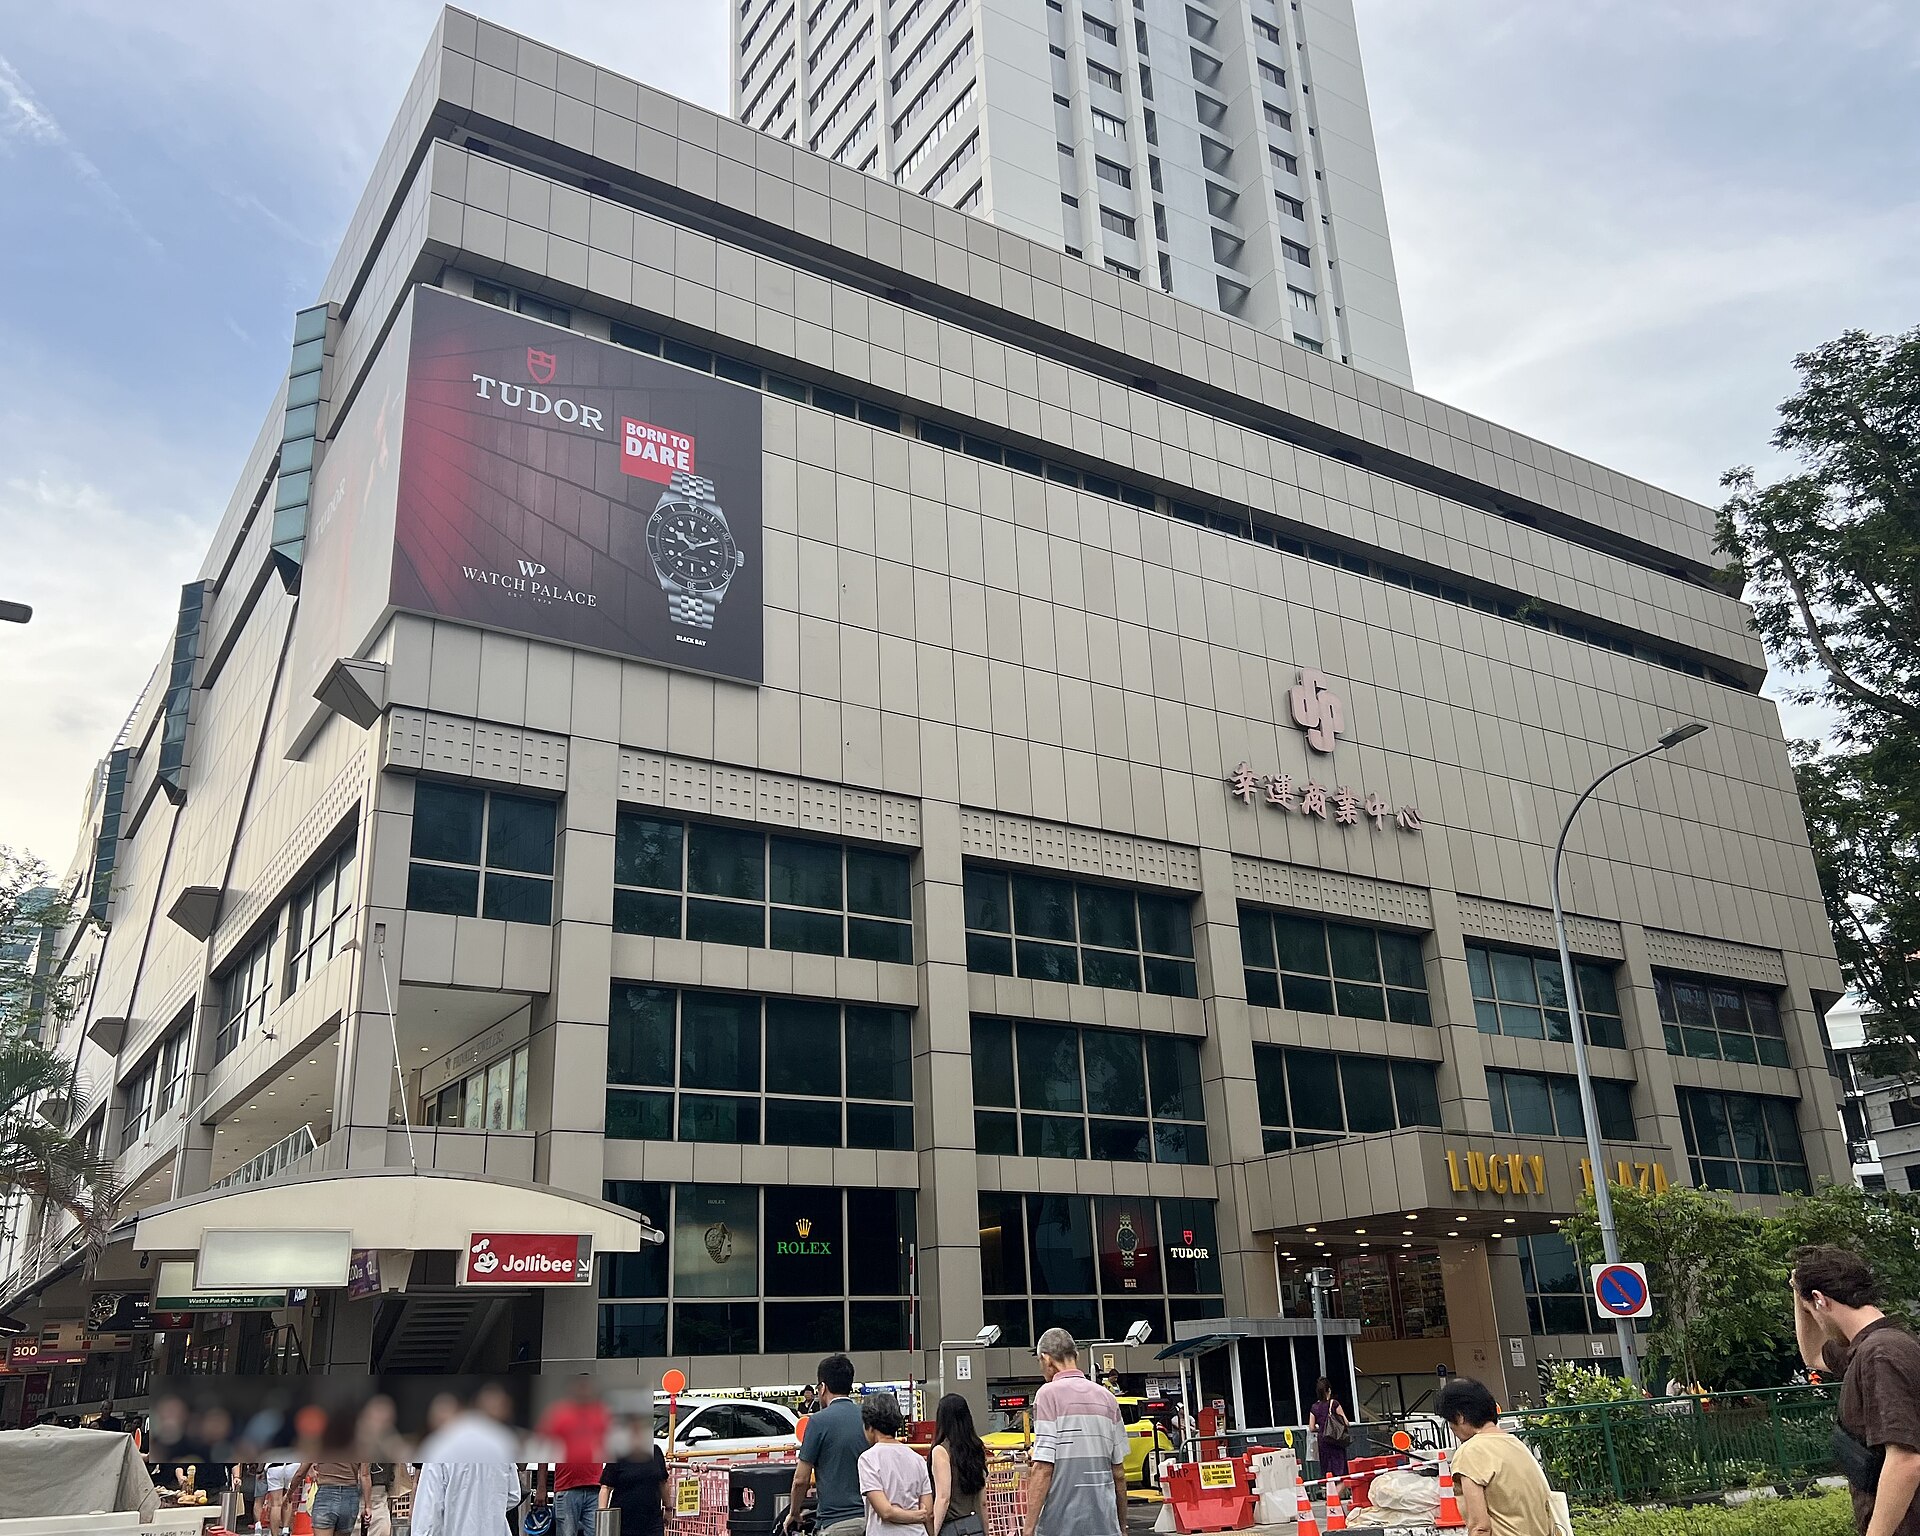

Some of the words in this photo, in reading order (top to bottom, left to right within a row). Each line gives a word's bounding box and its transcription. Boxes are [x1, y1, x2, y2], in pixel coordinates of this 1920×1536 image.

[472, 373, 605, 432] TUDOR
[626, 421, 667, 445] BORN
[670, 434, 690, 451] TO
[625, 435, 690, 472] DARE
[462, 565, 526, 592] WATCH
[530, 581, 597, 607] PALACE
[676, 634, 695, 645] BLACK
[1227, 760, 1425, 832] 幸運商業中心
[1446, 1150, 1546, 1196] LUCKY
[776, 1241, 832, 1255] ROLEX
[1170, 1247, 1210, 1260] TUDOR
[502, 1253, 573, 1273] Jollibee
[12, 1345, 39, 1357] 300
[761, 1388, 803, 1398] MONEY
